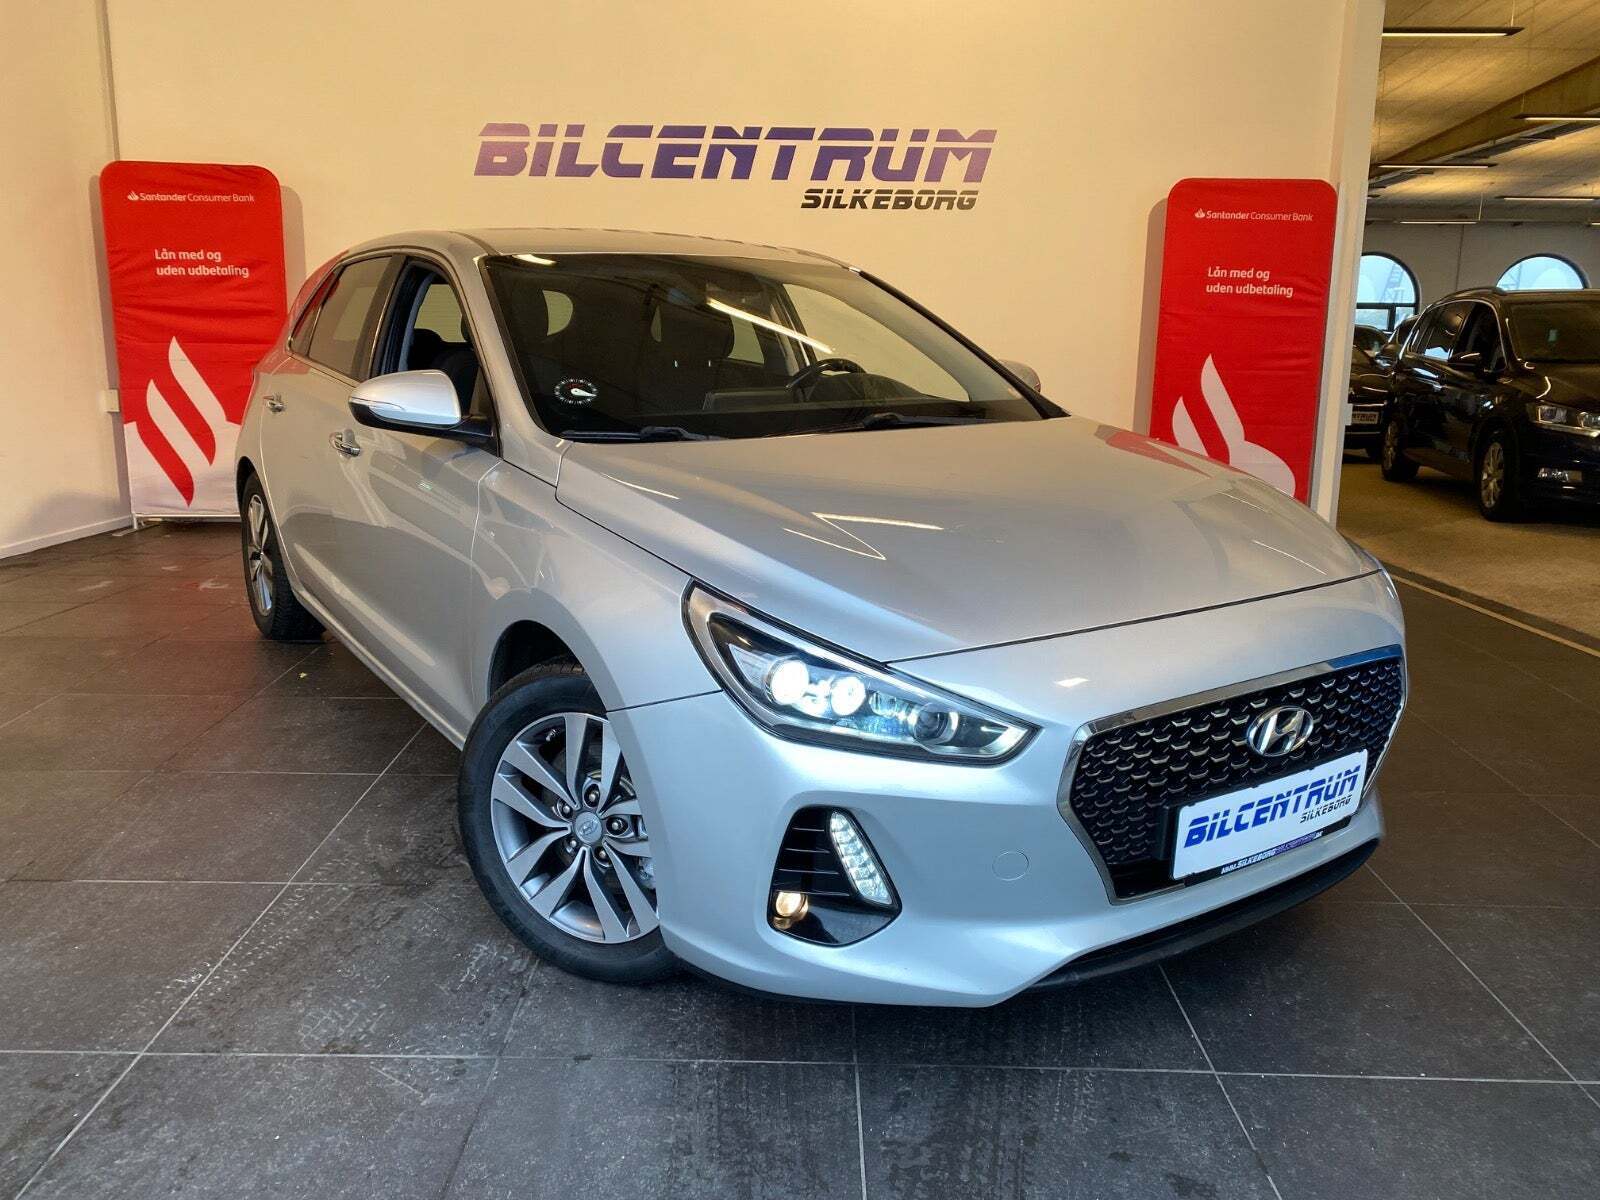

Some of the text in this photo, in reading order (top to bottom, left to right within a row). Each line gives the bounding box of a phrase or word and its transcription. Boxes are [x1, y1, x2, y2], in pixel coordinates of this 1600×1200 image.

[474, 123, 997, 182] BILCENTRUM
[140, 192, 255, 202] Santander Consumer Bank
[800, 189, 979, 210] SILKEBORG
[1206, 210, 1314, 221] Santander Consumer Bank
[154, 248, 222, 263] Lån med og
[156, 265, 250, 279] uden udbetaling
[1207, 266, 1271, 282] Lån med og
[1206, 282, 1294, 298] uden udbetaling
[1184, 765, 1361, 848] BILCENTRUM
[1300, 795, 1352, 824] SILKEBORG
